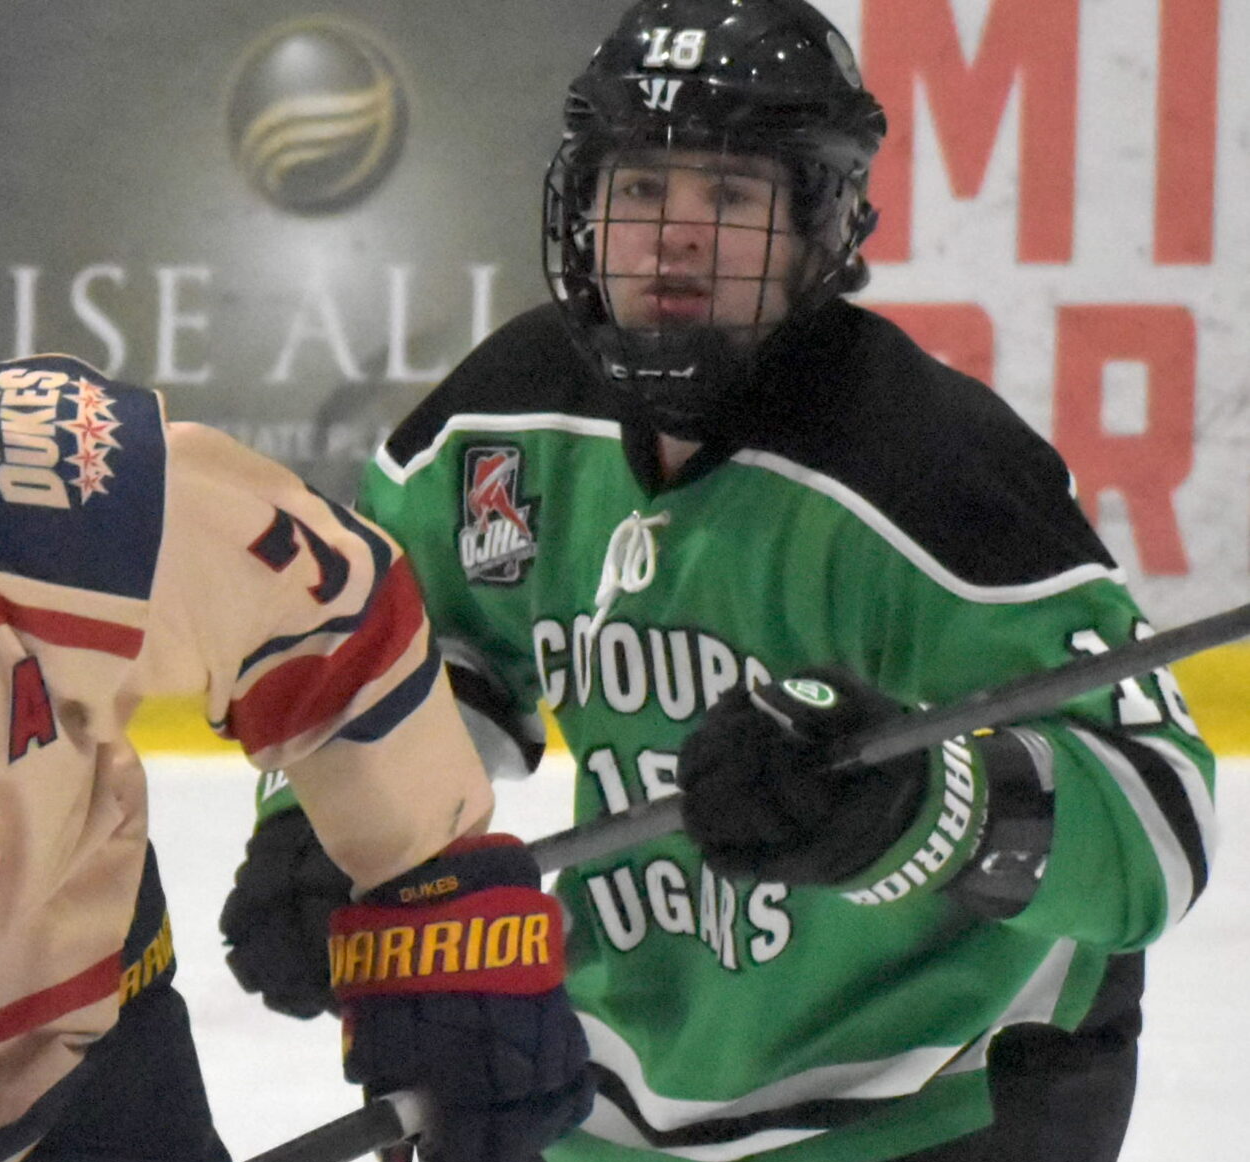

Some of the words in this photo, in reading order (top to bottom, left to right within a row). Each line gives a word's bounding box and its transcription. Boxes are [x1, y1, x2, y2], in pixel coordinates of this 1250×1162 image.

[642, 26, 706, 69] 18
[8, 654, 59, 764] A
[399, 875, 460, 903] DUKES
